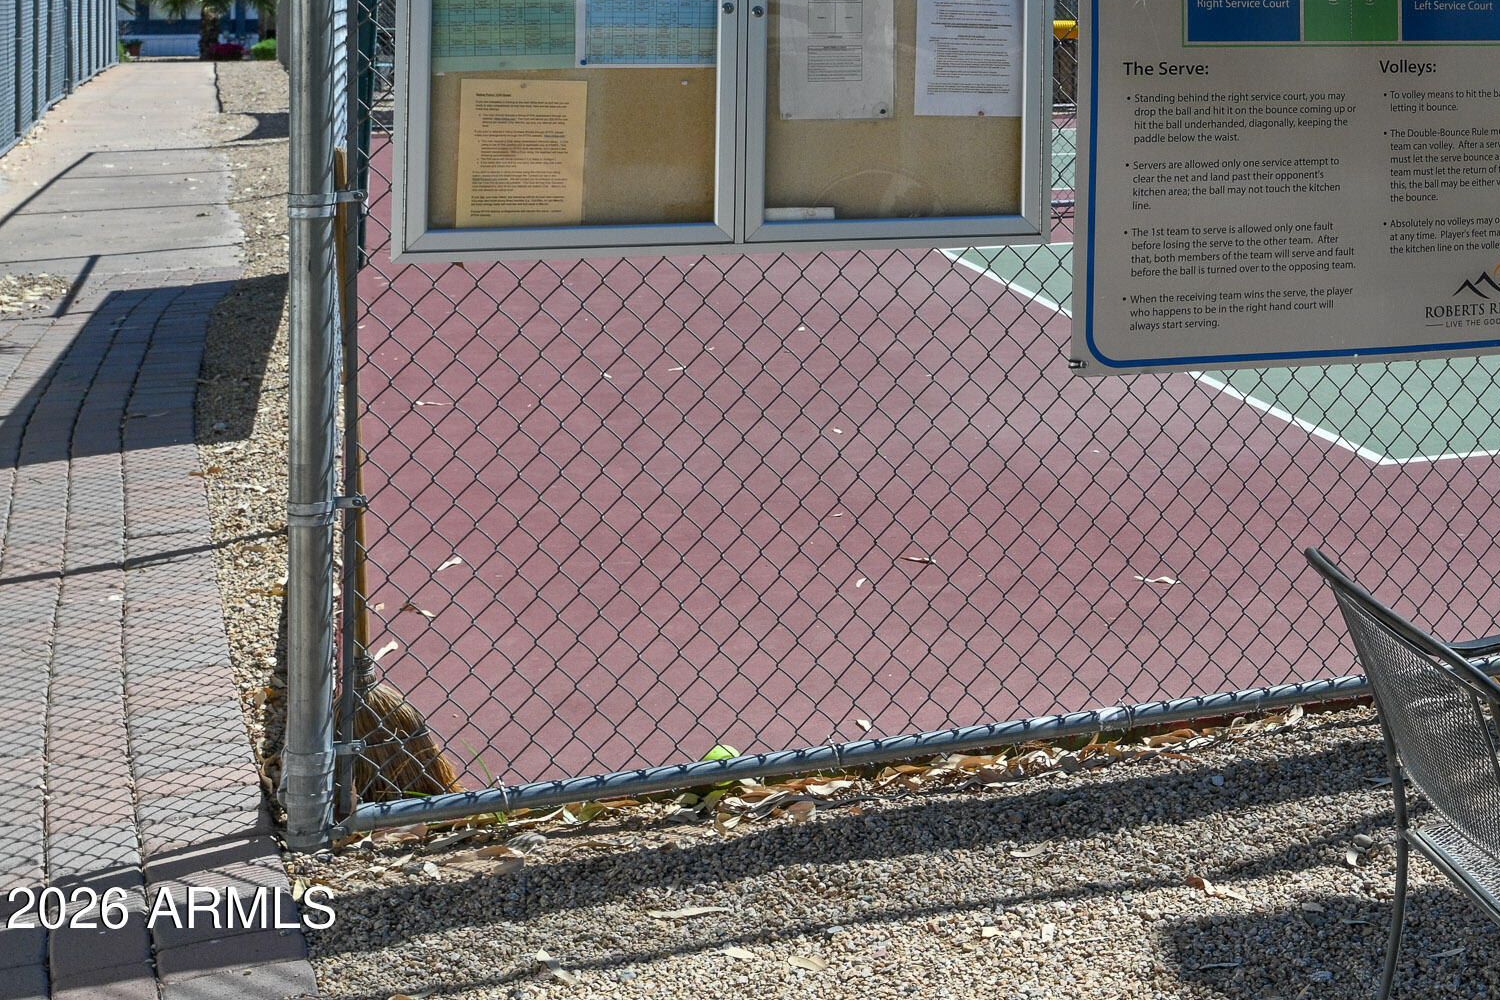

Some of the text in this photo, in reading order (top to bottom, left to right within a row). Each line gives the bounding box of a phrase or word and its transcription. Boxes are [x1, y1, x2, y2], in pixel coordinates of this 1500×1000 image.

[1414, 0, 1493, 10] Left Service Court
[1123, 62, 1209, 76] The Serve:
[1379, 60, 1436, 76] Volleys:
[1134, 92, 1346, 104] Standing behind the right service court, you may
[1389, 90, 1400, 100] To
[1401, 90, 1426, 101] volley
[1426, 92, 1454, 100] means
[1466, 90, 1477, 98] hit
[1478, 89, 1492, 98] the
[1134, 108, 1156, 117] drop
[1158, 107, 1174, 116] the
[1175, 106, 1192, 116] ball
[1194, 106, 1211, 115] and
[1213, 106, 1225, 115] hit
[1227, 106, 1233, 115] it
[1248, 106, 1264, 114] the
[1265, 105, 1299, 114] bounce
[1299, 105, 1332, 115] coming
[1334, 106, 1346, 117] up
[1390, 103, 1458, 114] letting it bounce.
[1134, 117, 1348, 130] hit the ball underhanded, diagonally, keeping the
[1134, 133, 1240, 144] paddle below the waist.
[1390, 219, 1434, 228] Absolutely
[1446, 217, 1475, 227] volleys
[1476, 218, 1493, 226] may
[1399, 234, 1415, 242] any
[1416, 232, 1437, 240] time.
[1471, 229, 1487, 237] feet
[1390, 245, 1404, 254] the
[1405, 244, 1436, 253] kitchen
[1437, 243, 1452, 252] line
[1466, 242, 1480, 250] the
[1130, 308, 1150, 317] who
[1152, 308, 1192, 317] happens
[1205, 305, 1217, 314] be
[1218, 305, 1227, 313] in
[1229, 304, 1244, 313] the
[1246, 303, 1267, 314] right
[1269, 302, 1292, 311] hand
[1293, 302, 1317, 310] court
[1318, 300, 1334, 309] will
[1425, 304, 1484, 318] ROBERTS
[1129, 319, 1220, 332] always start serving.
